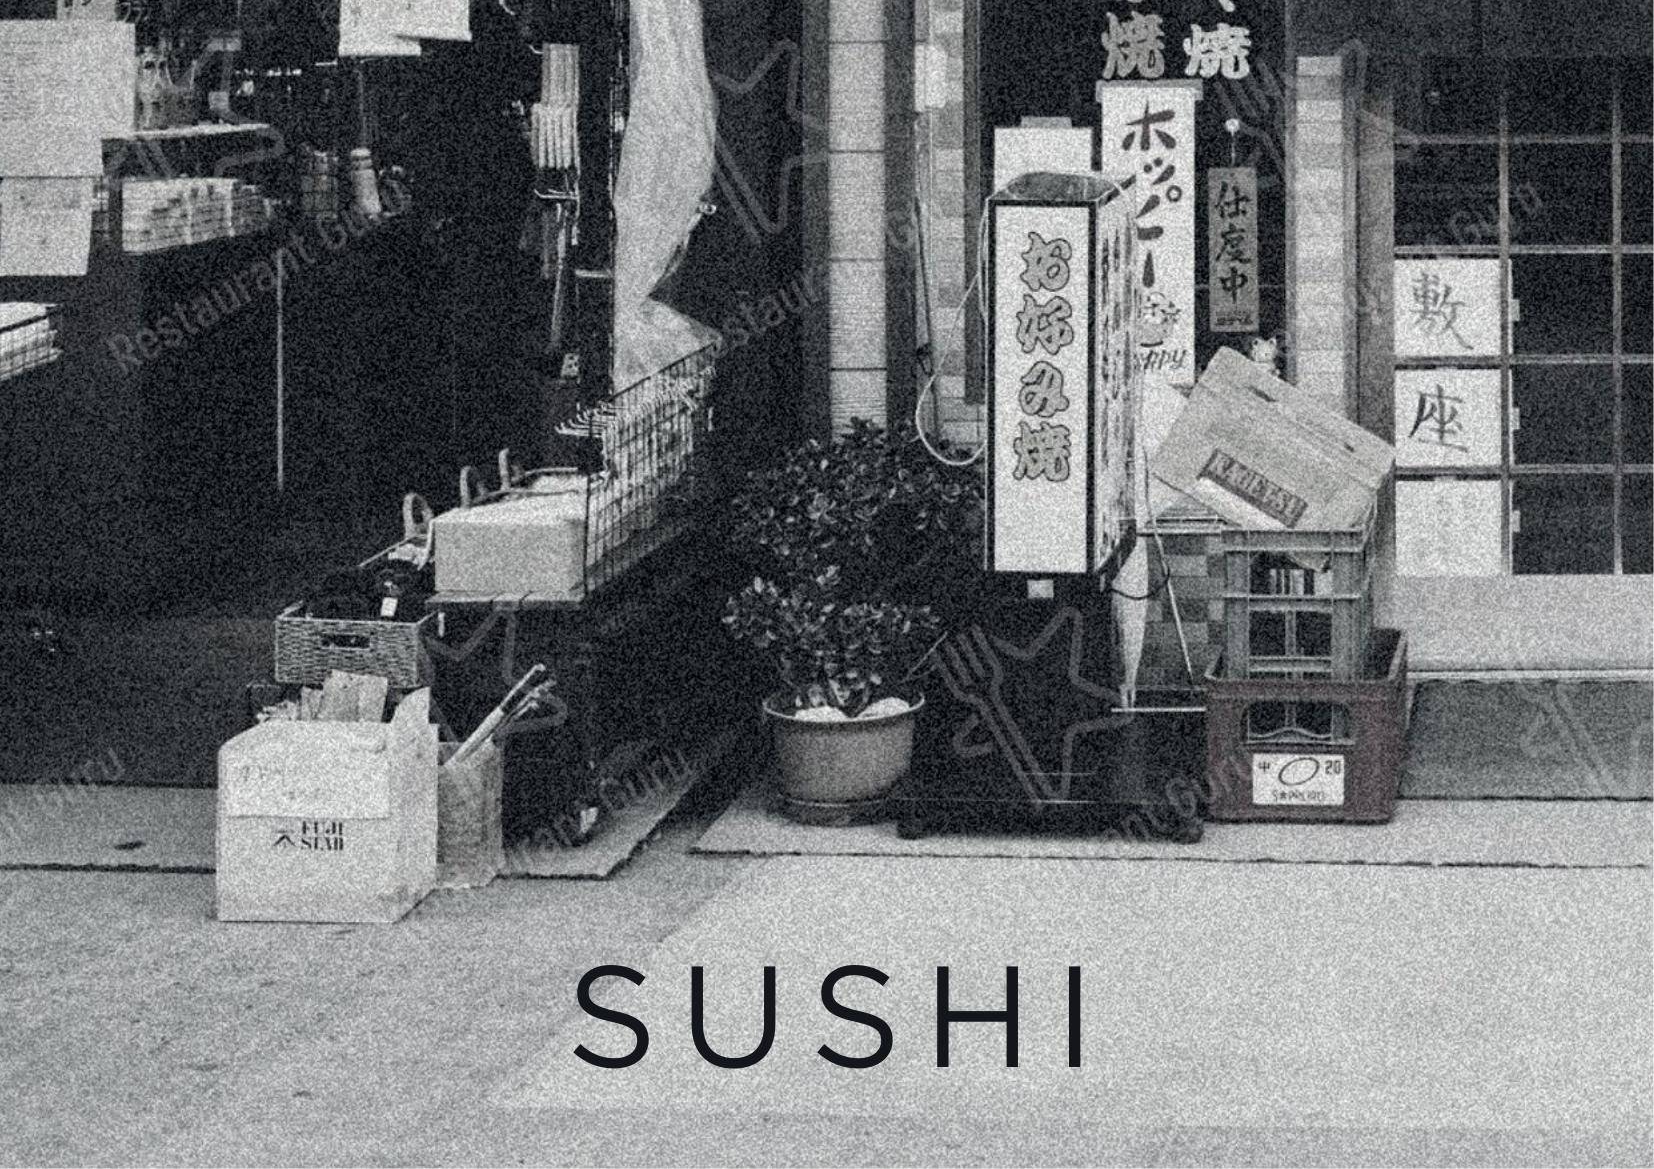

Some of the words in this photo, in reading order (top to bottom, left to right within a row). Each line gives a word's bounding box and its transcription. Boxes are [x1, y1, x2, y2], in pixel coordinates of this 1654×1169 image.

[1122, 101, 1182, 287] ホッピー
[1215, 181, 1251, 304] 仕度中
[1012, 231, 1075, 483] お好み焼
